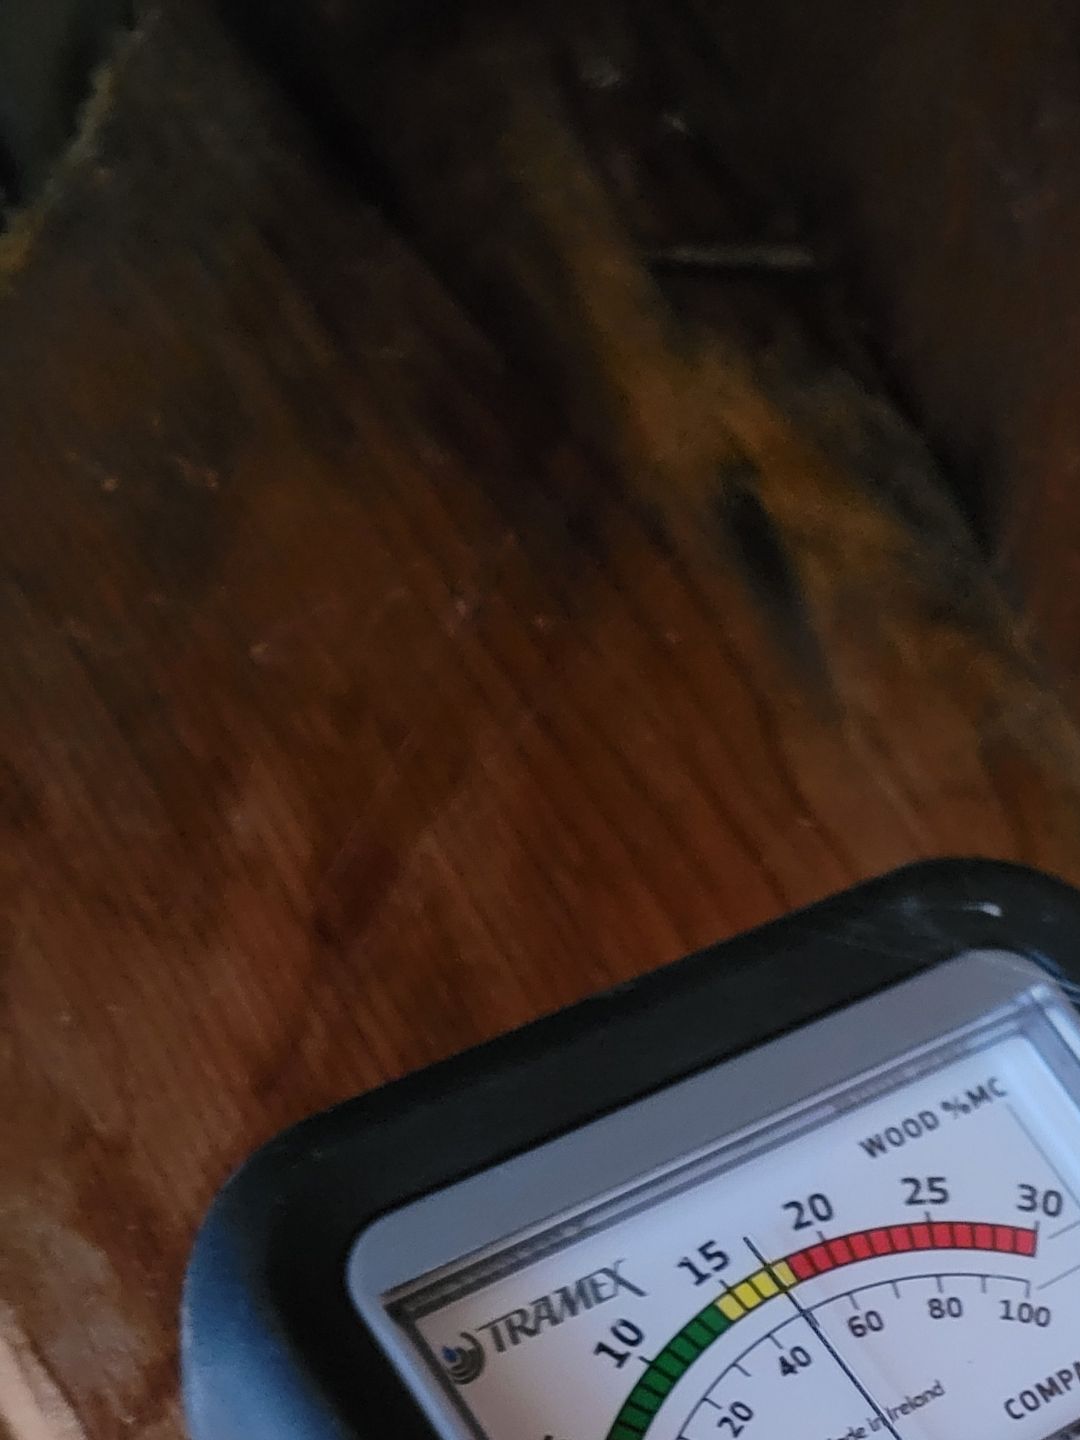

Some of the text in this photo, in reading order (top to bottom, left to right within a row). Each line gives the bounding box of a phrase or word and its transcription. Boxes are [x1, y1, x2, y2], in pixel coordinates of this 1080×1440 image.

[857, 1076, 1008, 1159] WOOD %MC
[478, 1258, 647, 1354] TRAMEX
[593, 1319, 646, 1369] 10
[677, 1240, 731, 1286] 15
[783, 1191, 835, 1231] 20
[900, 1176, 949, 1205] 25
[1015, 1184, 1063, 1217] 30
[717, 1400, 755, 1439] 20
[777, 1344, 813, 1378] 40
[847, 1309, 885, 1338] 60
[927, 1296, 964, 1320] 80
[998, 1300, 1052, 1328] 100
[884, 1379, 946, 1423] Ireland
